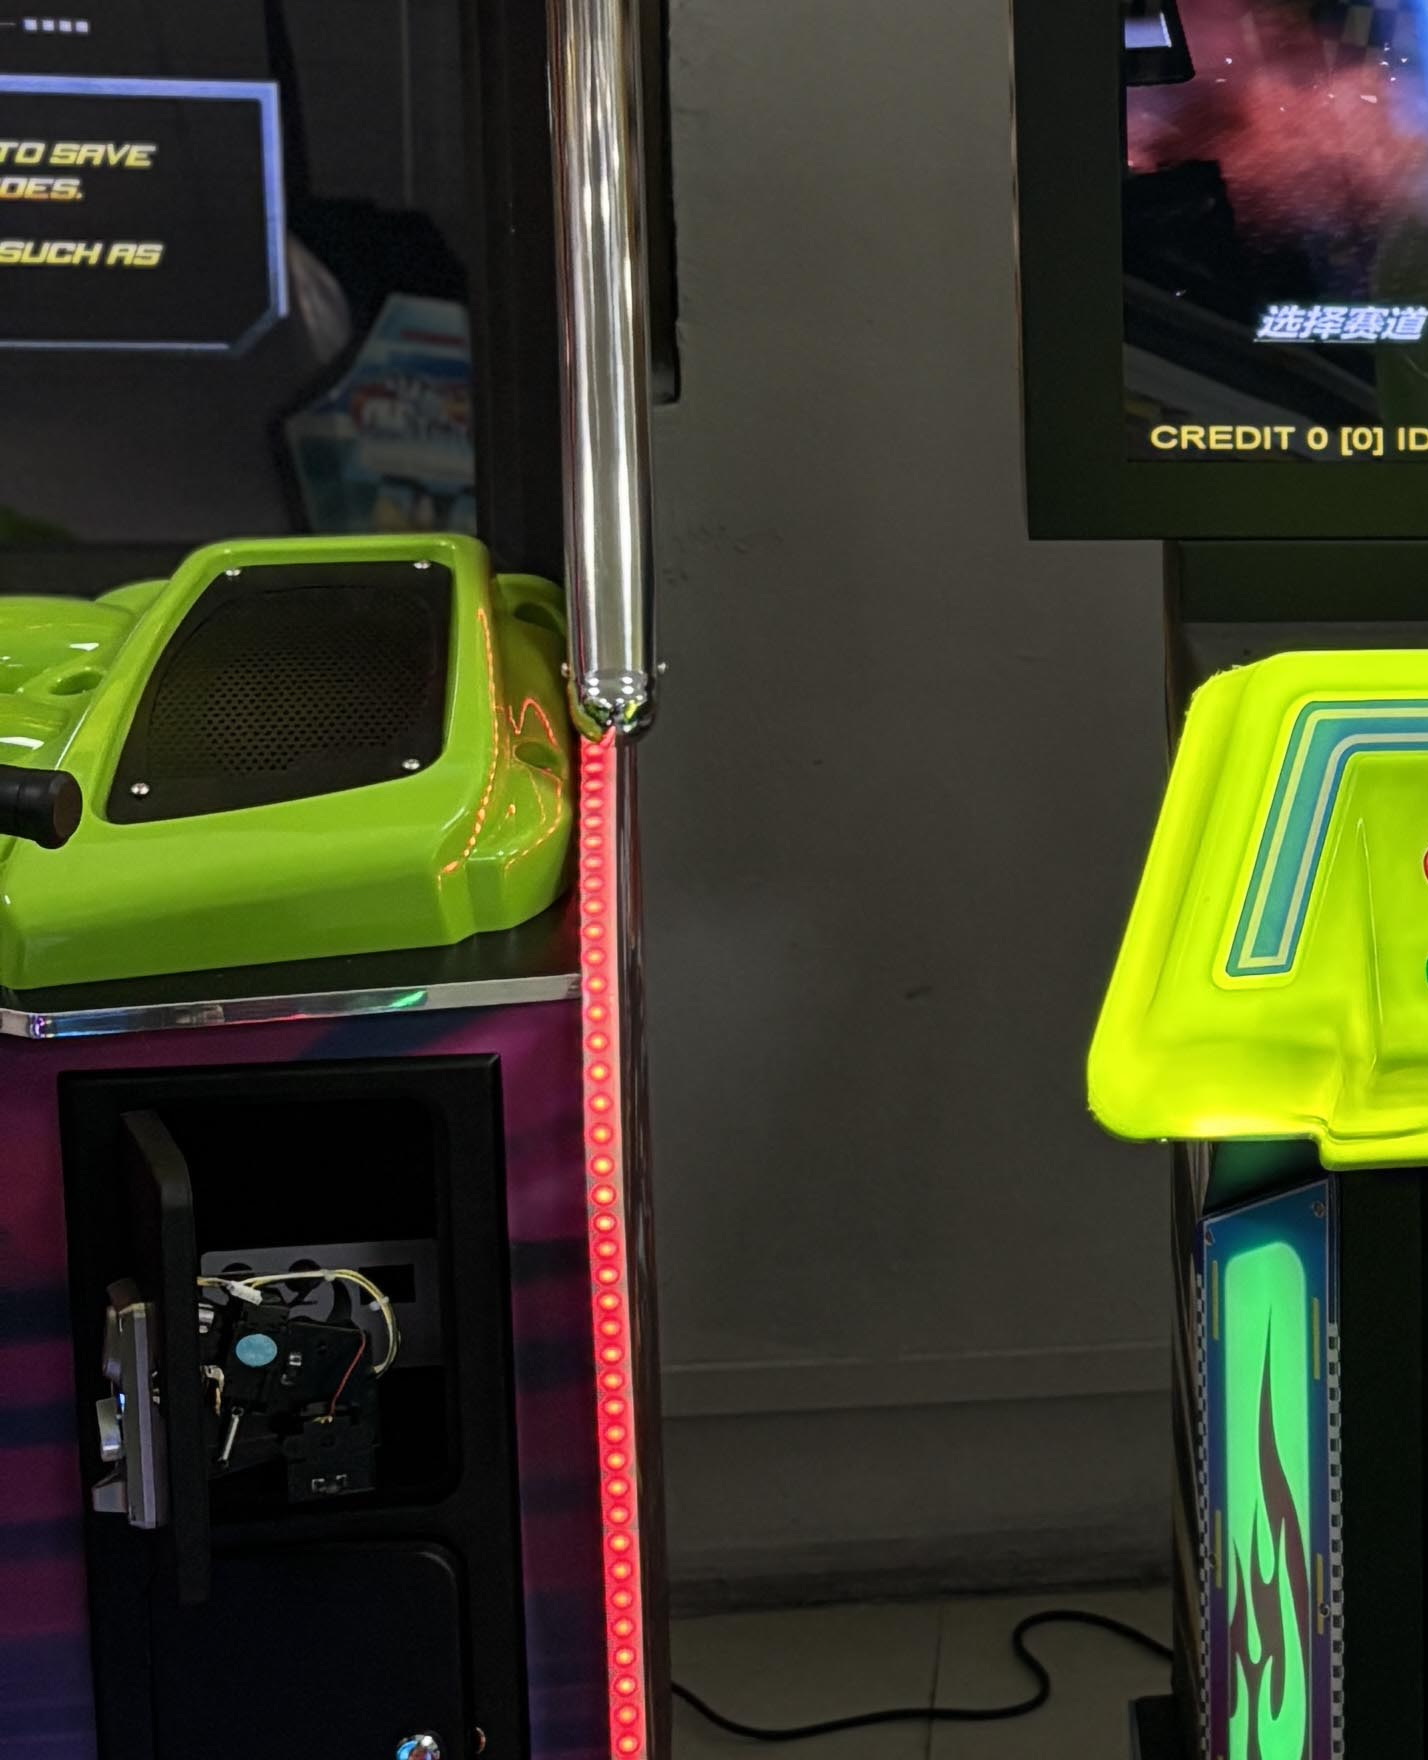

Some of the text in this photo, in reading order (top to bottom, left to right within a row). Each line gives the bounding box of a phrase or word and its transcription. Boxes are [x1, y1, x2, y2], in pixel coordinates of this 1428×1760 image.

[50, 142, 156, 167] SAVE
[106, 243, 163, 266] AS
[1150, 424, 1297, 451] CREDIT
[1306, 425, 1329, 451] 0
[1341, 426, 1384, 456] [0]
